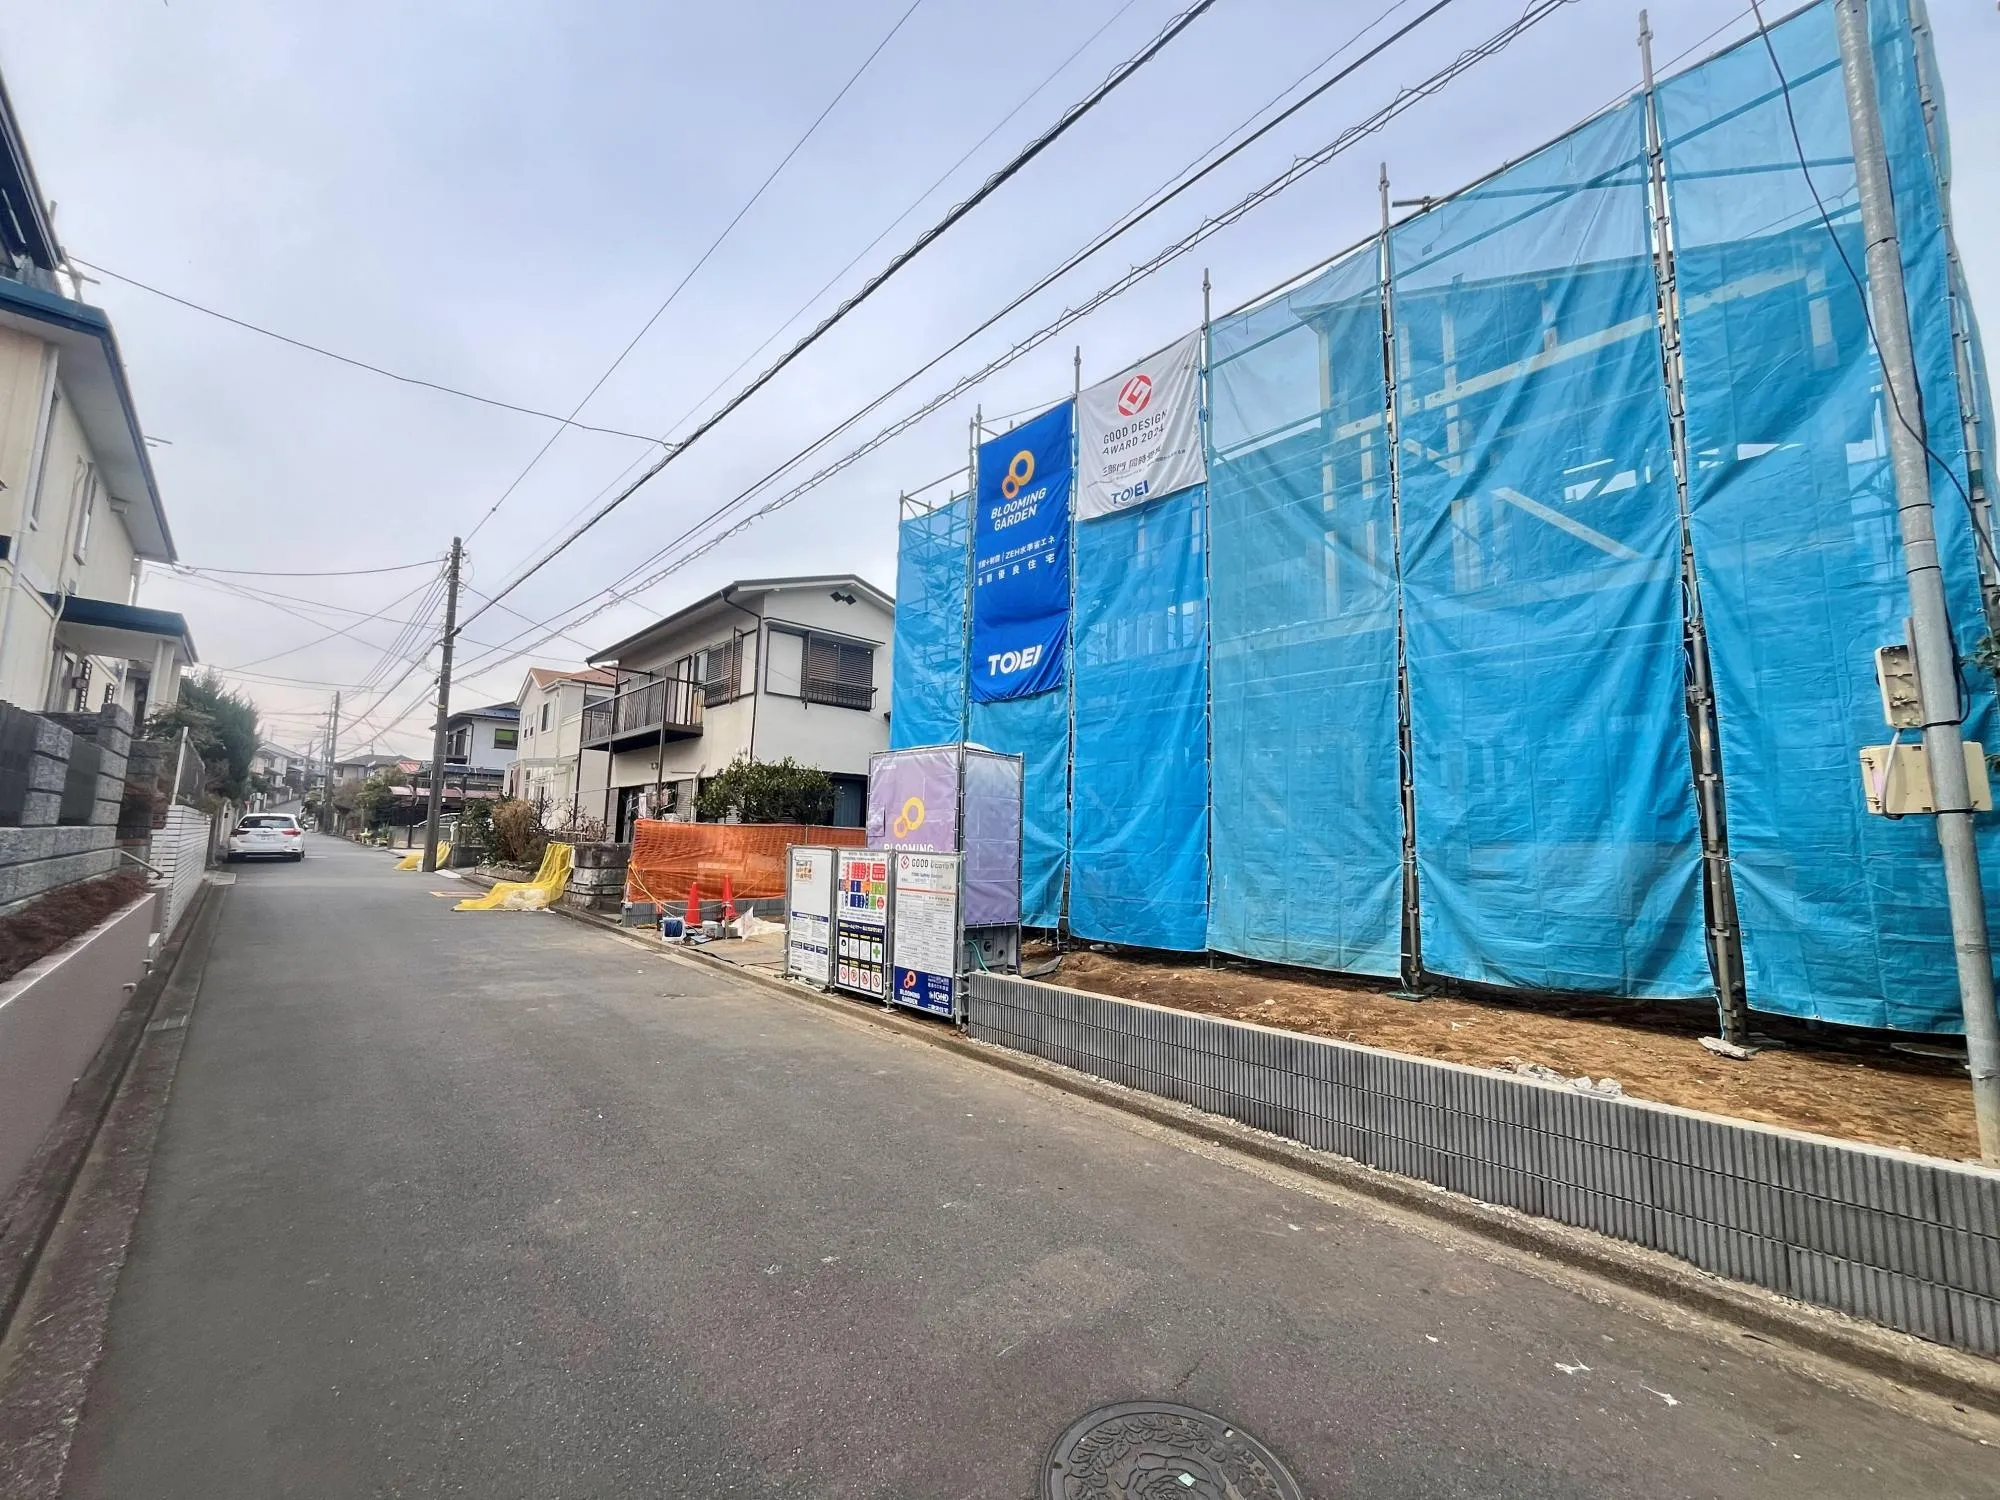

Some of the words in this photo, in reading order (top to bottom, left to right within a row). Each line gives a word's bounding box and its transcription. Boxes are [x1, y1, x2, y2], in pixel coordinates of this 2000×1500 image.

[1102, 437, 1138, 456] AWARD
[1141, 424, 1164, 443] 2024
[1103, 426, 1128, 444] GOOD
[1131, 409, 1167, 433] DESIGN
[991, 488, 1047, 520] BLOOMING
[1111, 480, 1150, 504] TOEI
[994, 503, 1038, 531] GARDEN
[988, 644, 1043, 676] TOEI
[911, 858, 929, 868] GOOD
